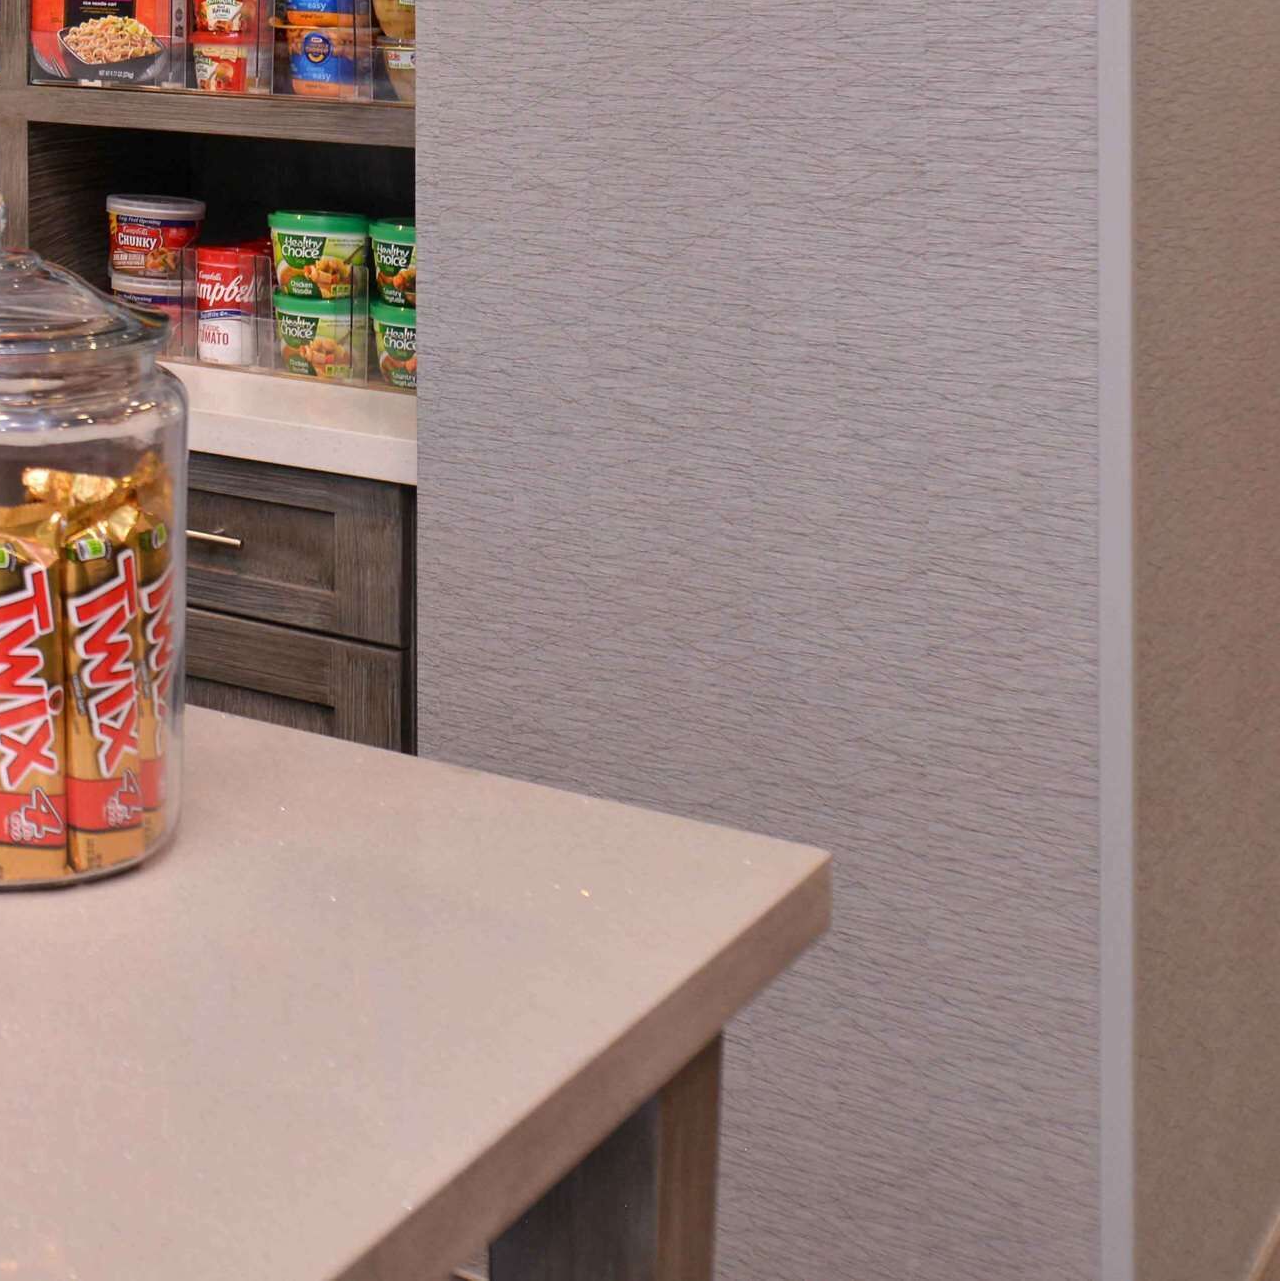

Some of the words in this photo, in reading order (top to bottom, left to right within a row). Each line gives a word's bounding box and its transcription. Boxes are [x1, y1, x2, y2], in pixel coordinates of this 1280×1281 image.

[307, 2, 327, 12] easy
[118, 231, 158, 251] CHUNKY
[284, 235, 323, 251] Healthy
[281, 245, 320, 260] Choice
[376, 242, 410, 258] Healthy
[376, 253, 408, 268] Choice
[281, 316, 316, 330] Healthy
[280, 325, 314, 339] Choice
